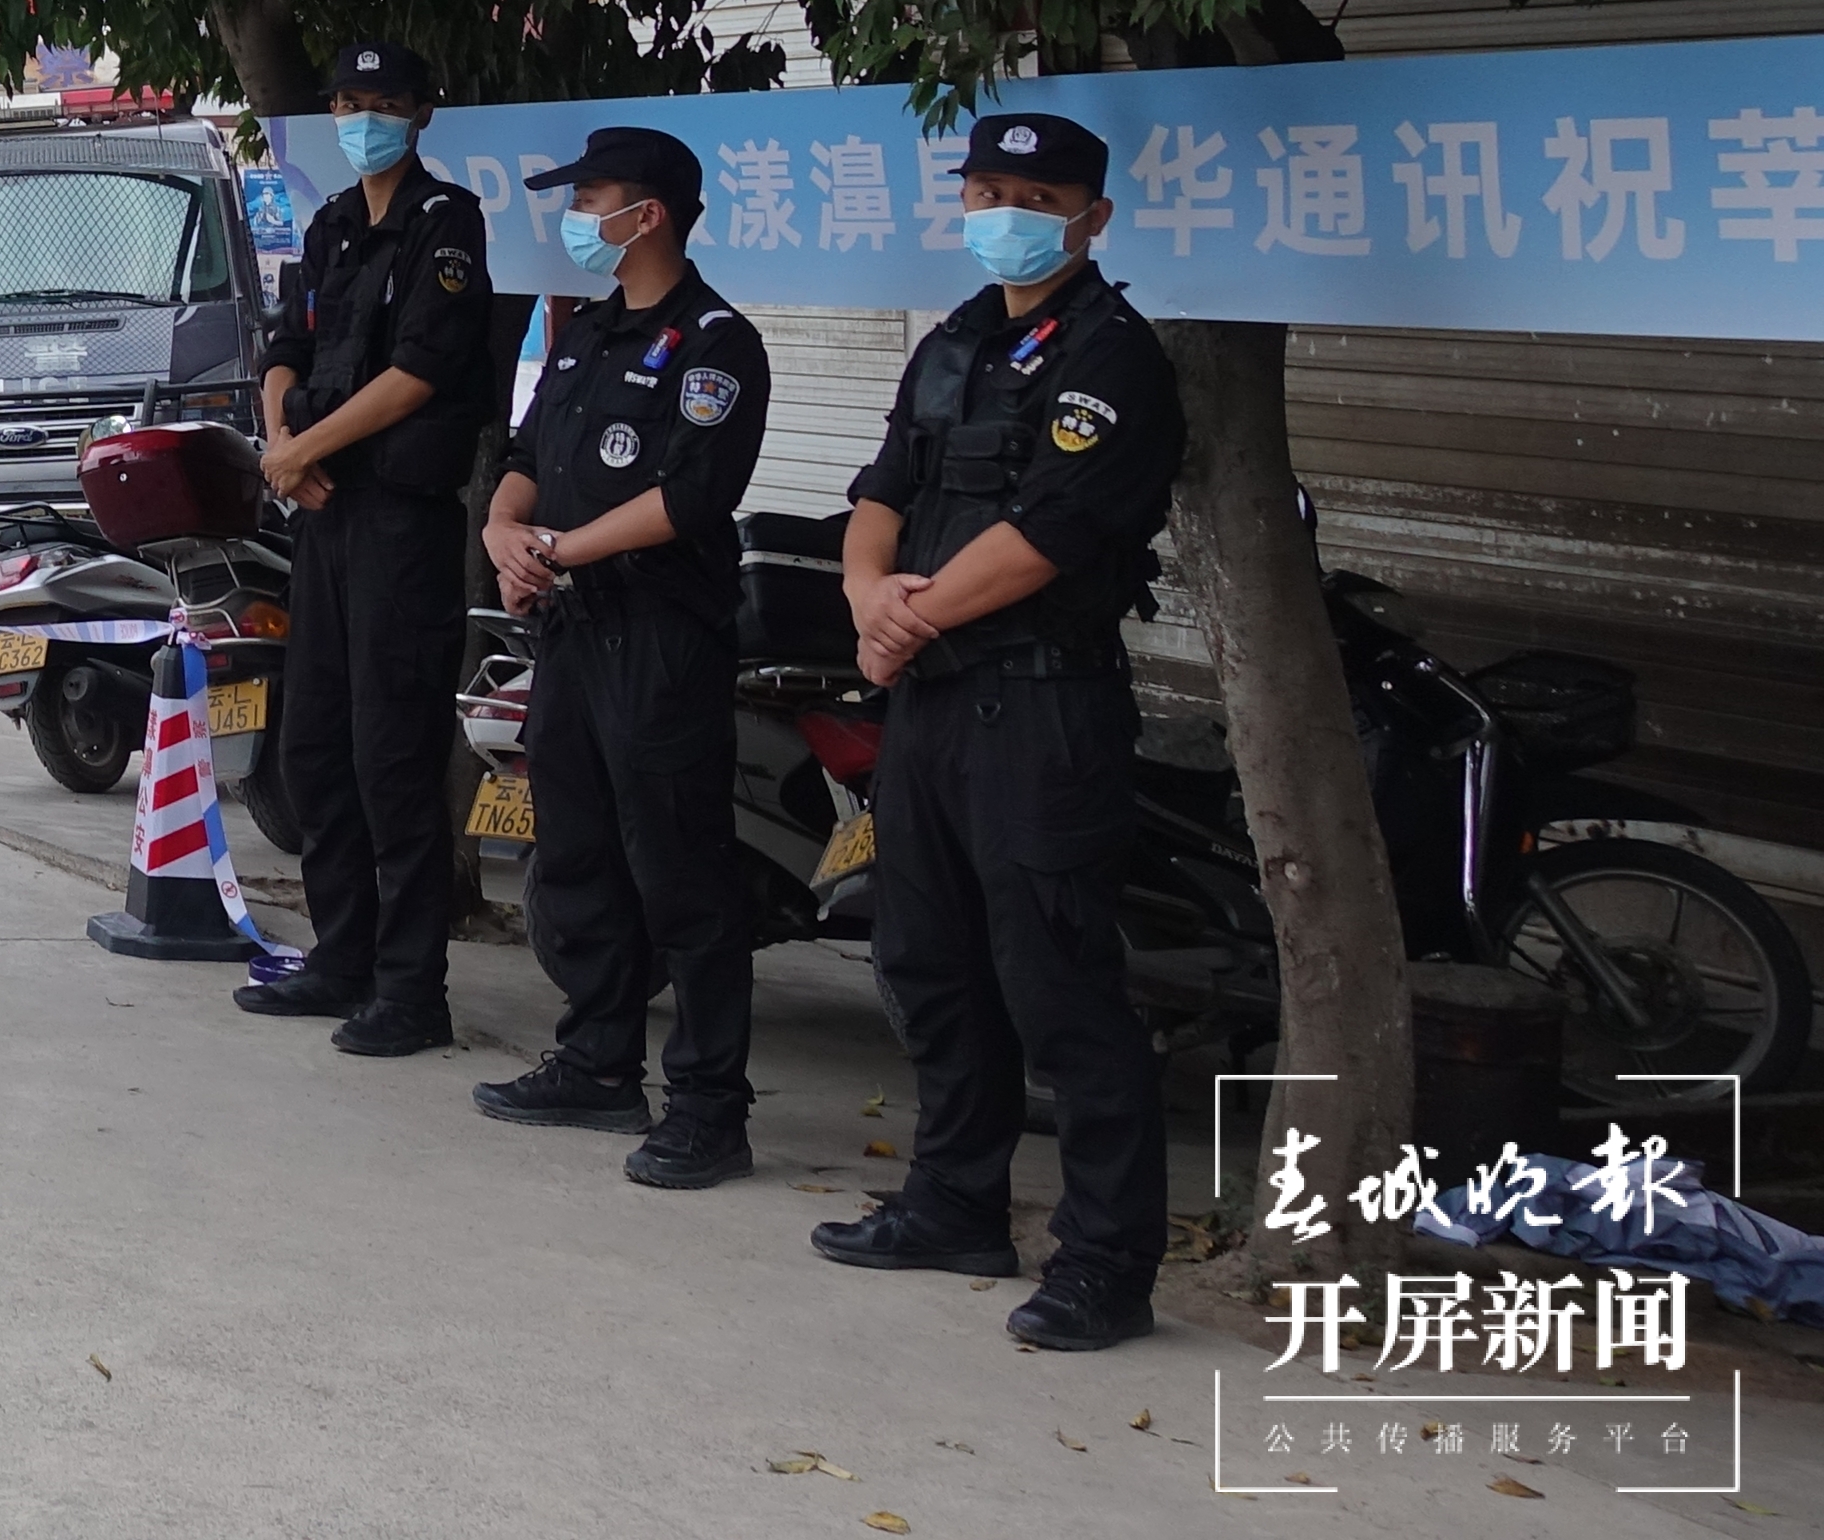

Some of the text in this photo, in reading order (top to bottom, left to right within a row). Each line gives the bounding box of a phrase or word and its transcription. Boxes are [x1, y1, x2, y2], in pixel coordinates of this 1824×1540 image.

[1067, 394, 1111, 416] SWAT
[0, 428, 33, 443] Ford
[478, 805, 535, 836] TN65
